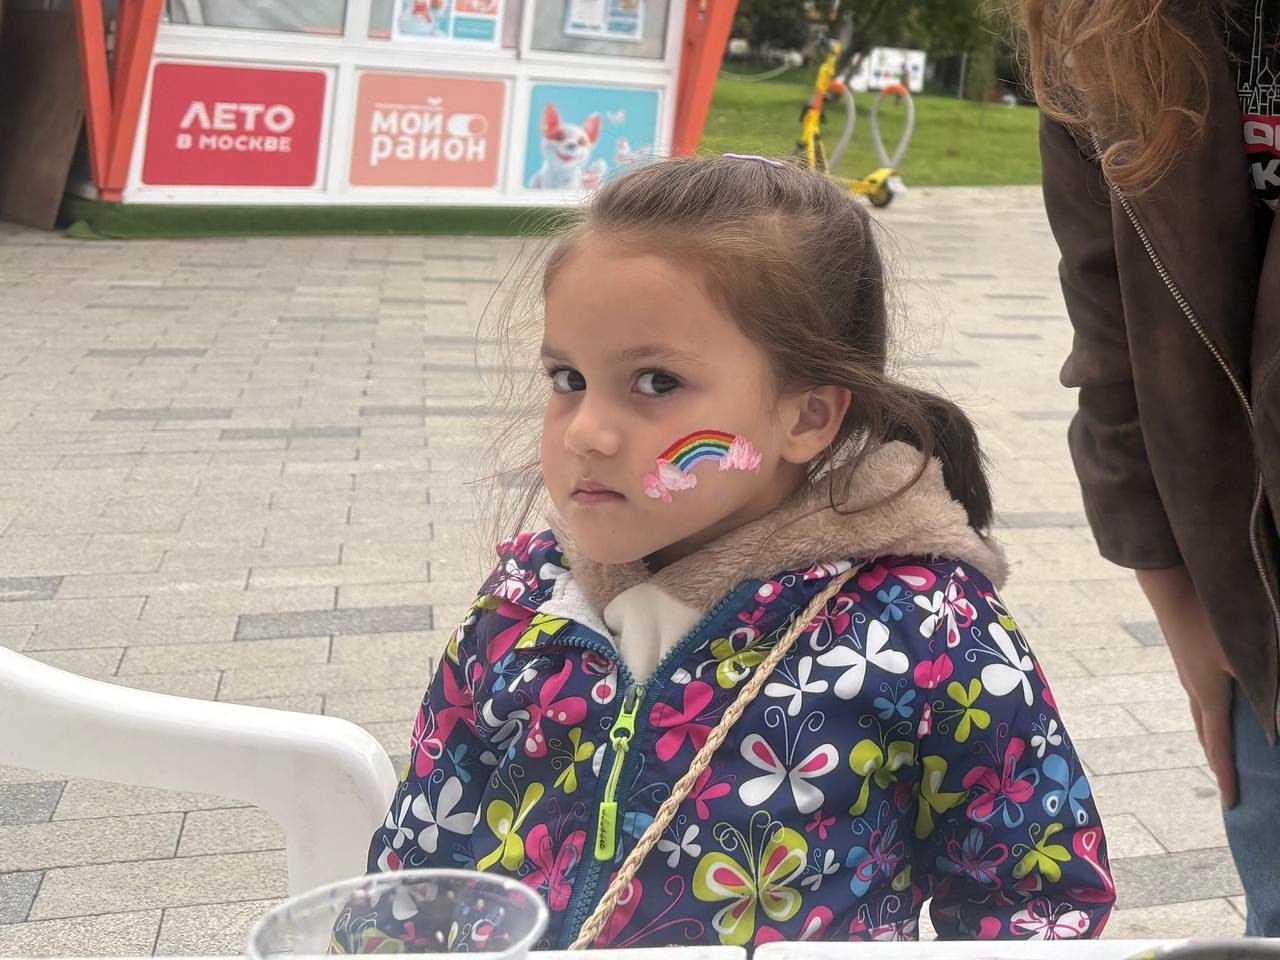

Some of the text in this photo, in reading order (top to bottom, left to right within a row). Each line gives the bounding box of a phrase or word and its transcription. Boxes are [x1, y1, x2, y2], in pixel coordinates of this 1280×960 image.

[179, 100, 296, 133] ЛЕТО
[175, 133, 293, 153] В МОСКВЕ
